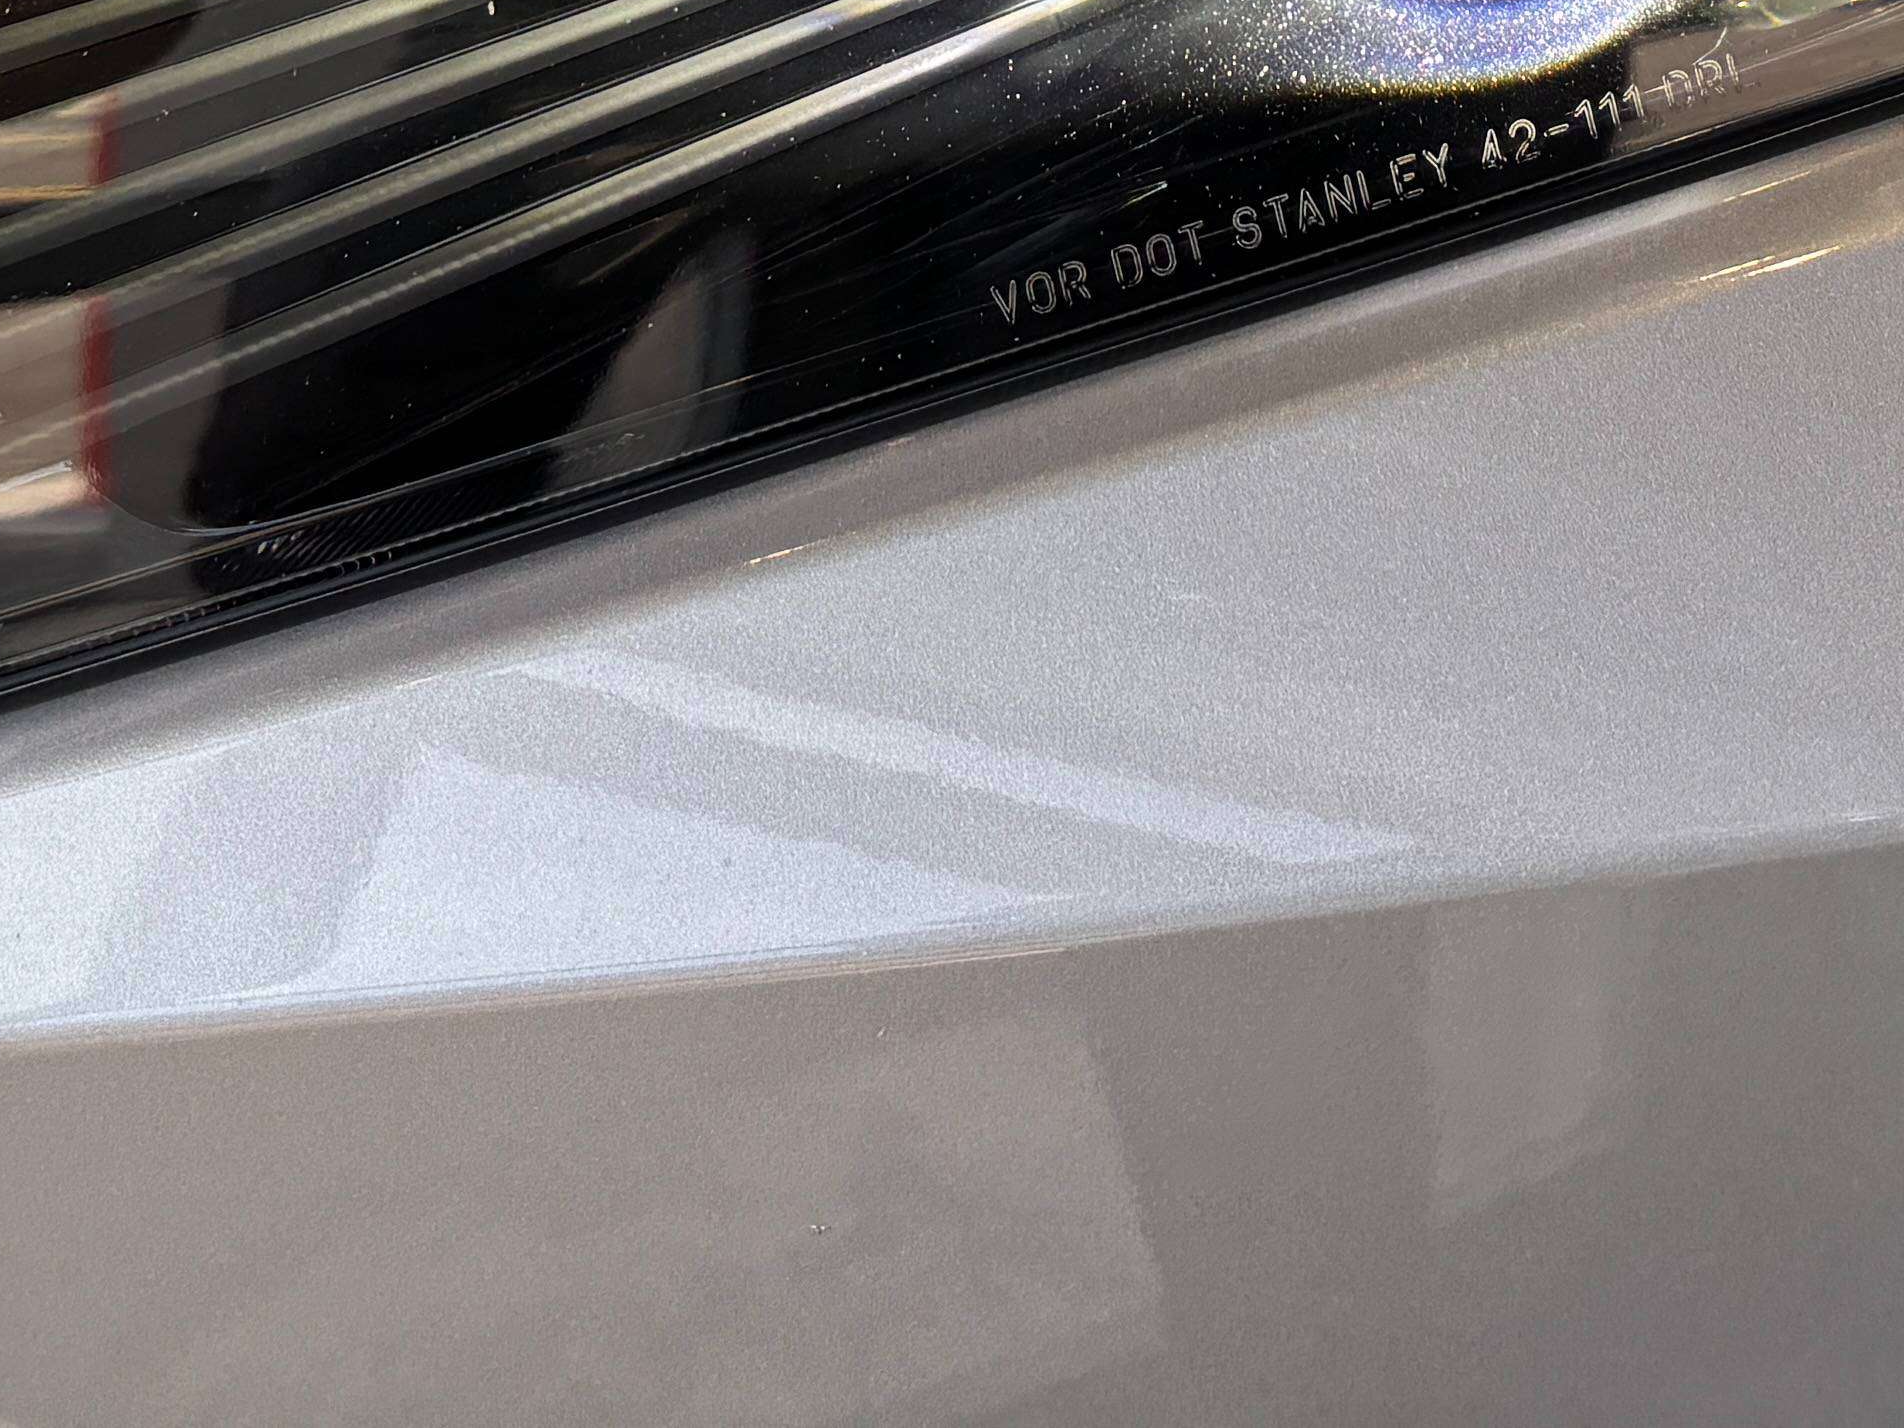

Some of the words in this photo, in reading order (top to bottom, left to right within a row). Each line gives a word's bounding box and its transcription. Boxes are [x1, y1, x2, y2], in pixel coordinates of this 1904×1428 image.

[990, 259, 1092, 325] VOR
[1110, 220, 1204, 290] DOT
[1231, 142, 1450, 250] STANLEY
